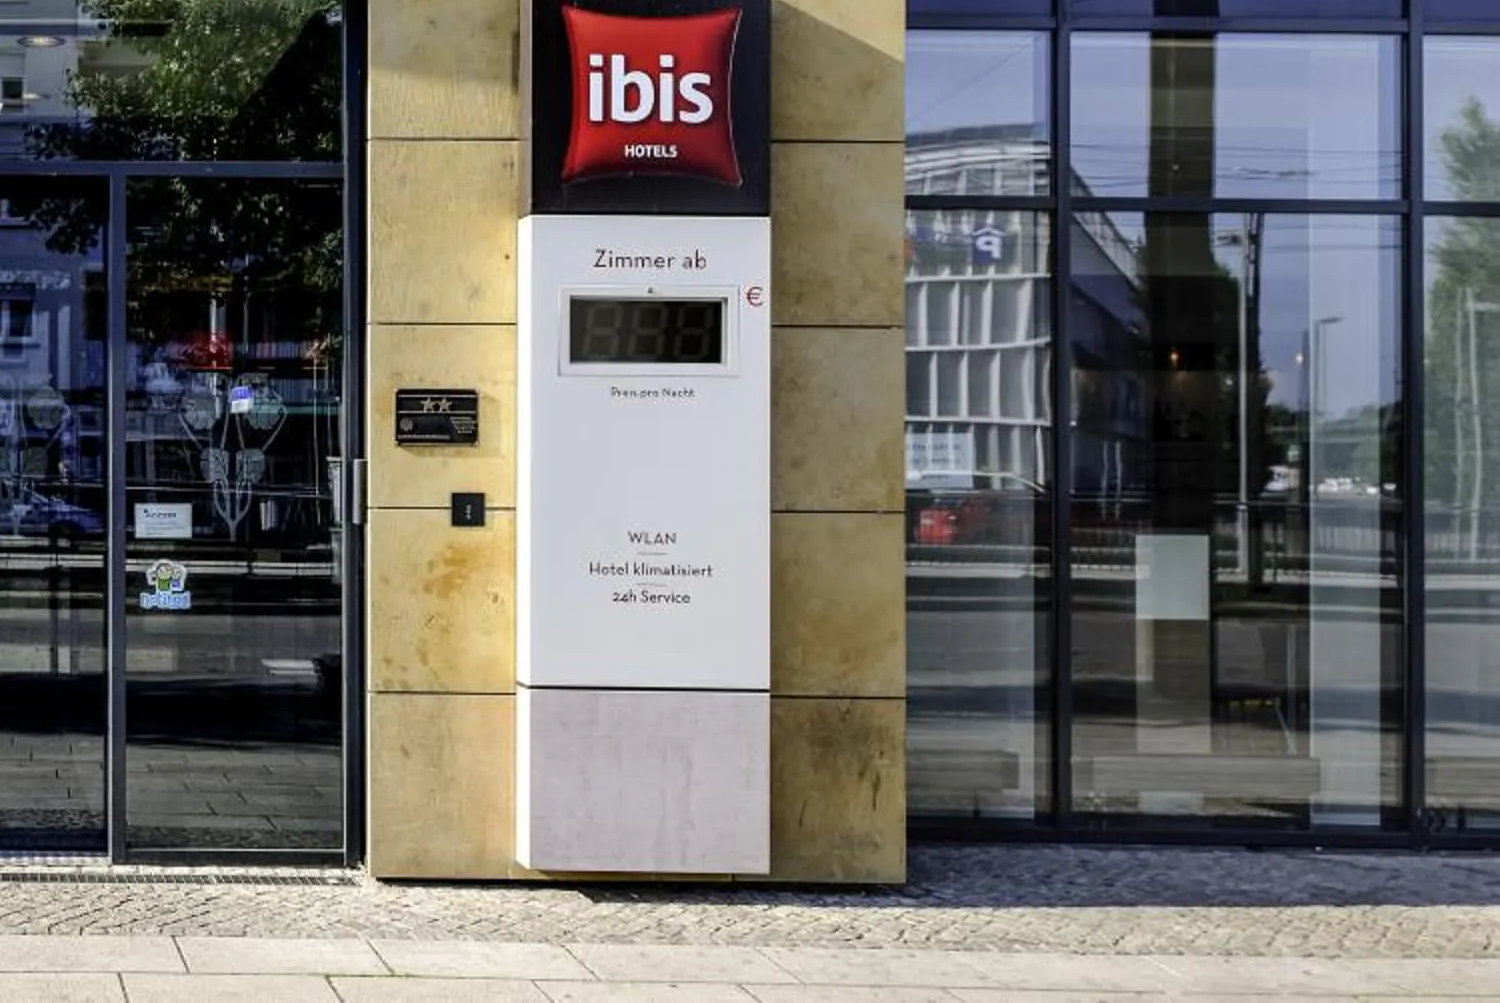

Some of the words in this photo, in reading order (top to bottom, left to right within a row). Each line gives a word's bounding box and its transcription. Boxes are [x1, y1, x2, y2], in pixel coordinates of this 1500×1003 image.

[589, 53, 713, 124] ibis
[624, 144, 678, 158] HOTELS
[593, 249, 676, 270] Zimmer
[682, 249, 707, 270] ab
[746, 285, 765, 308] €
[662, 387, 695, 398] Nacht
[627, 531, 677, 545] WLAN
[589, 561, 629, 576] Hotel
[633, 561, 713, 577] klimatisiert
[612, 588, 637, 602] 24h
[641, 588, 691, 604] Service
